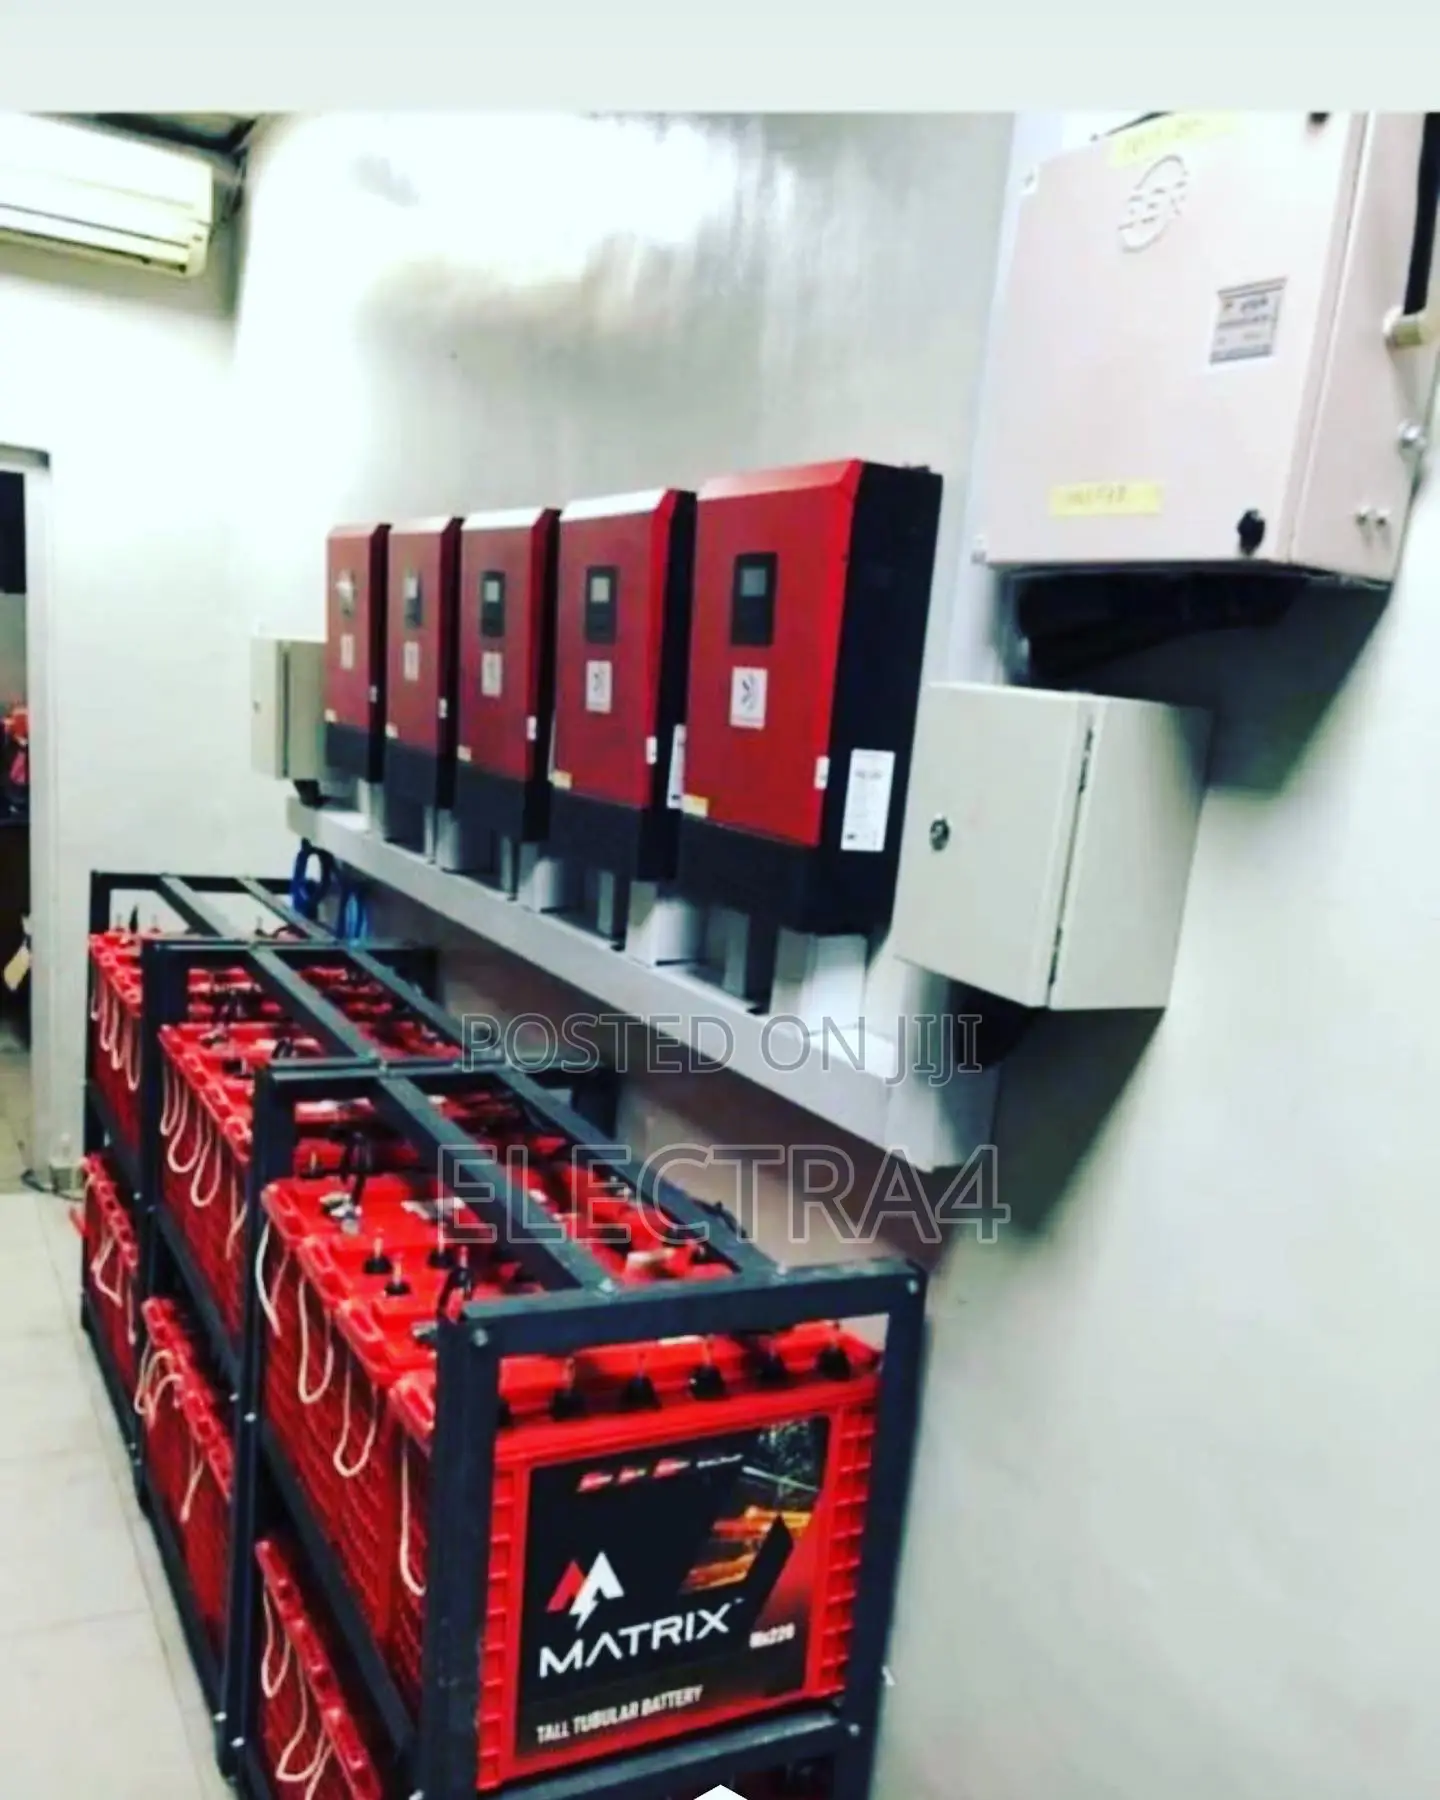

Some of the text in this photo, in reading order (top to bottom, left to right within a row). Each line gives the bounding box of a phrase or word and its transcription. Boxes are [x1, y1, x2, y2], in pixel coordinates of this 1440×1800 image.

[539, 1602, 732, 1678] MATRIX
[536, 1684, 704, 1744] TALL TUBULAR BATTERY
